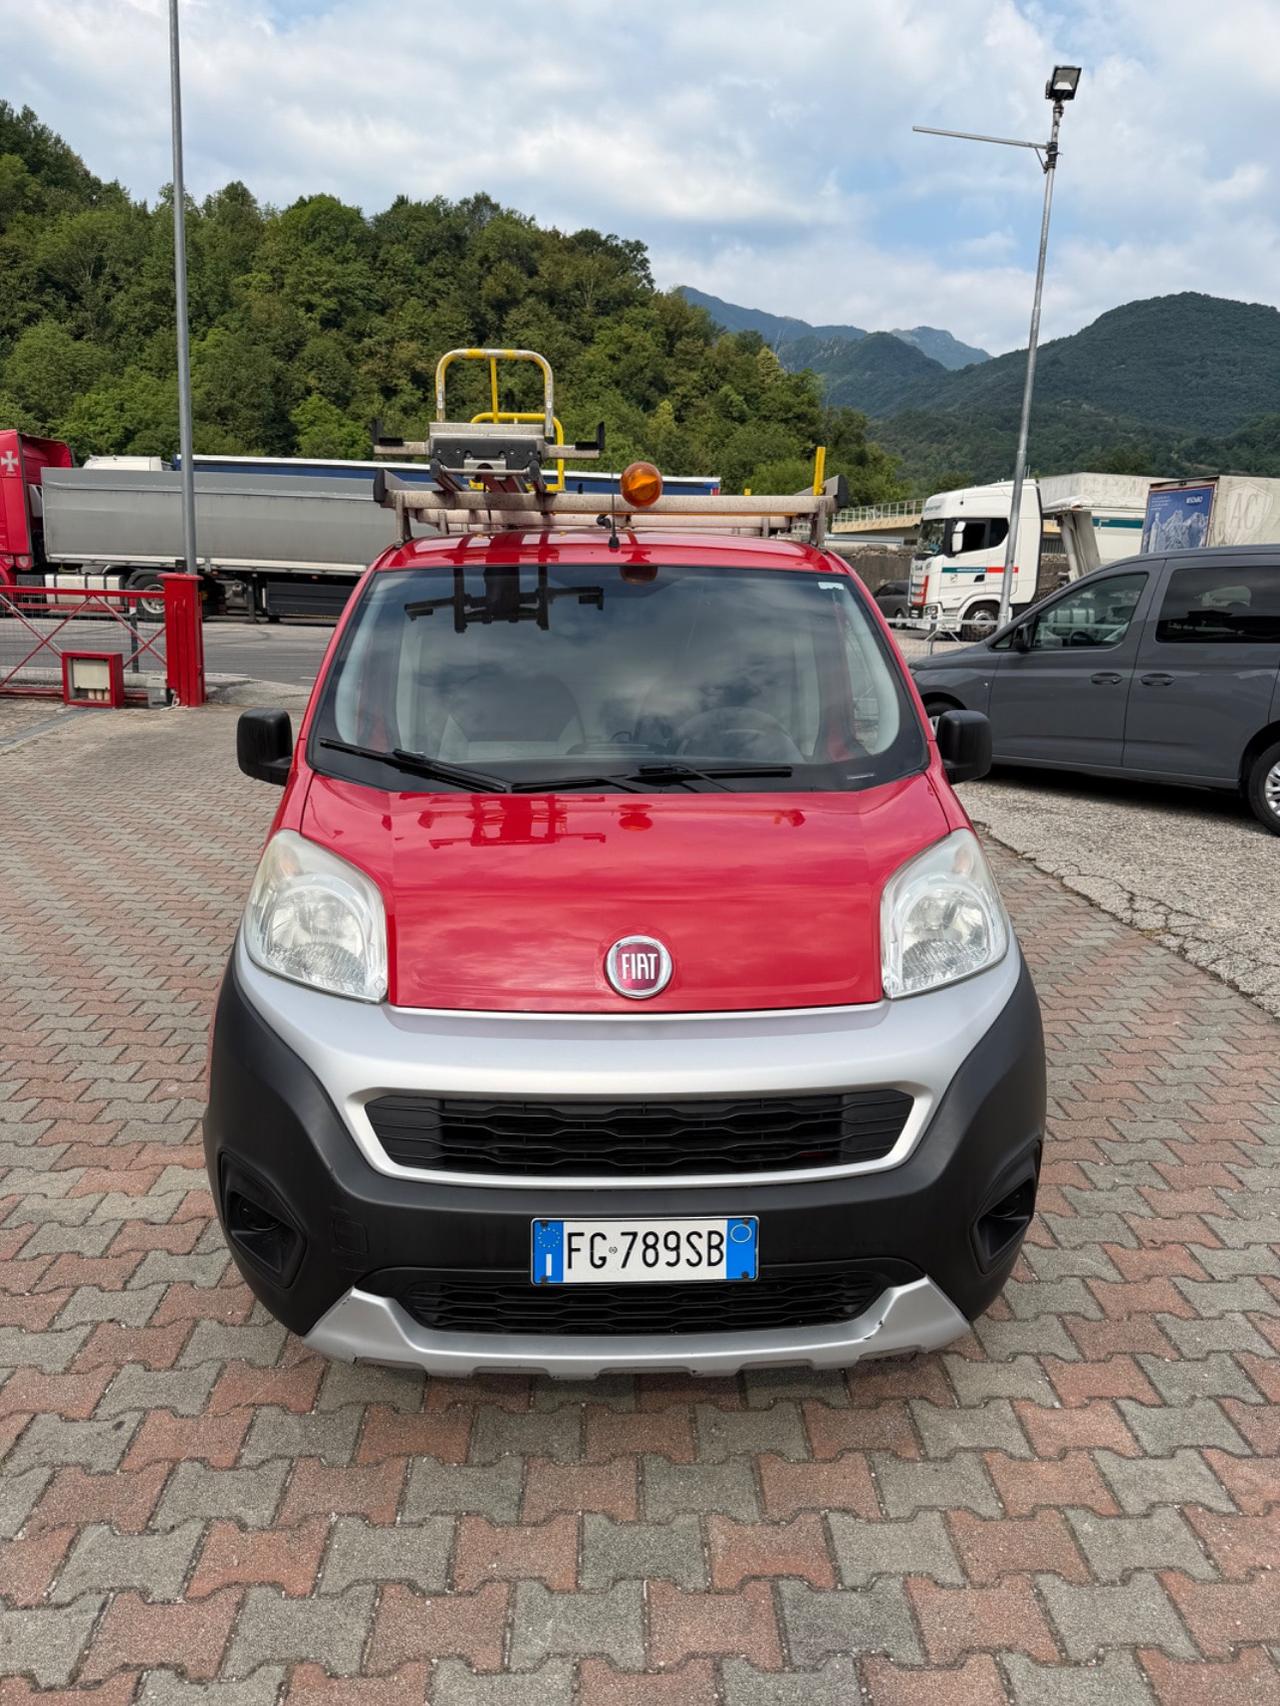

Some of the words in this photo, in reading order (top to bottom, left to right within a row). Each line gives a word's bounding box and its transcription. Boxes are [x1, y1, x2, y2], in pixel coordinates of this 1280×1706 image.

[621, 953, 658, 980] FIAT
[567, 1231, 607, 1270] FG
[621, 1229, 725, 1269] 789SB
[545, 1253, 553, 1277] I
